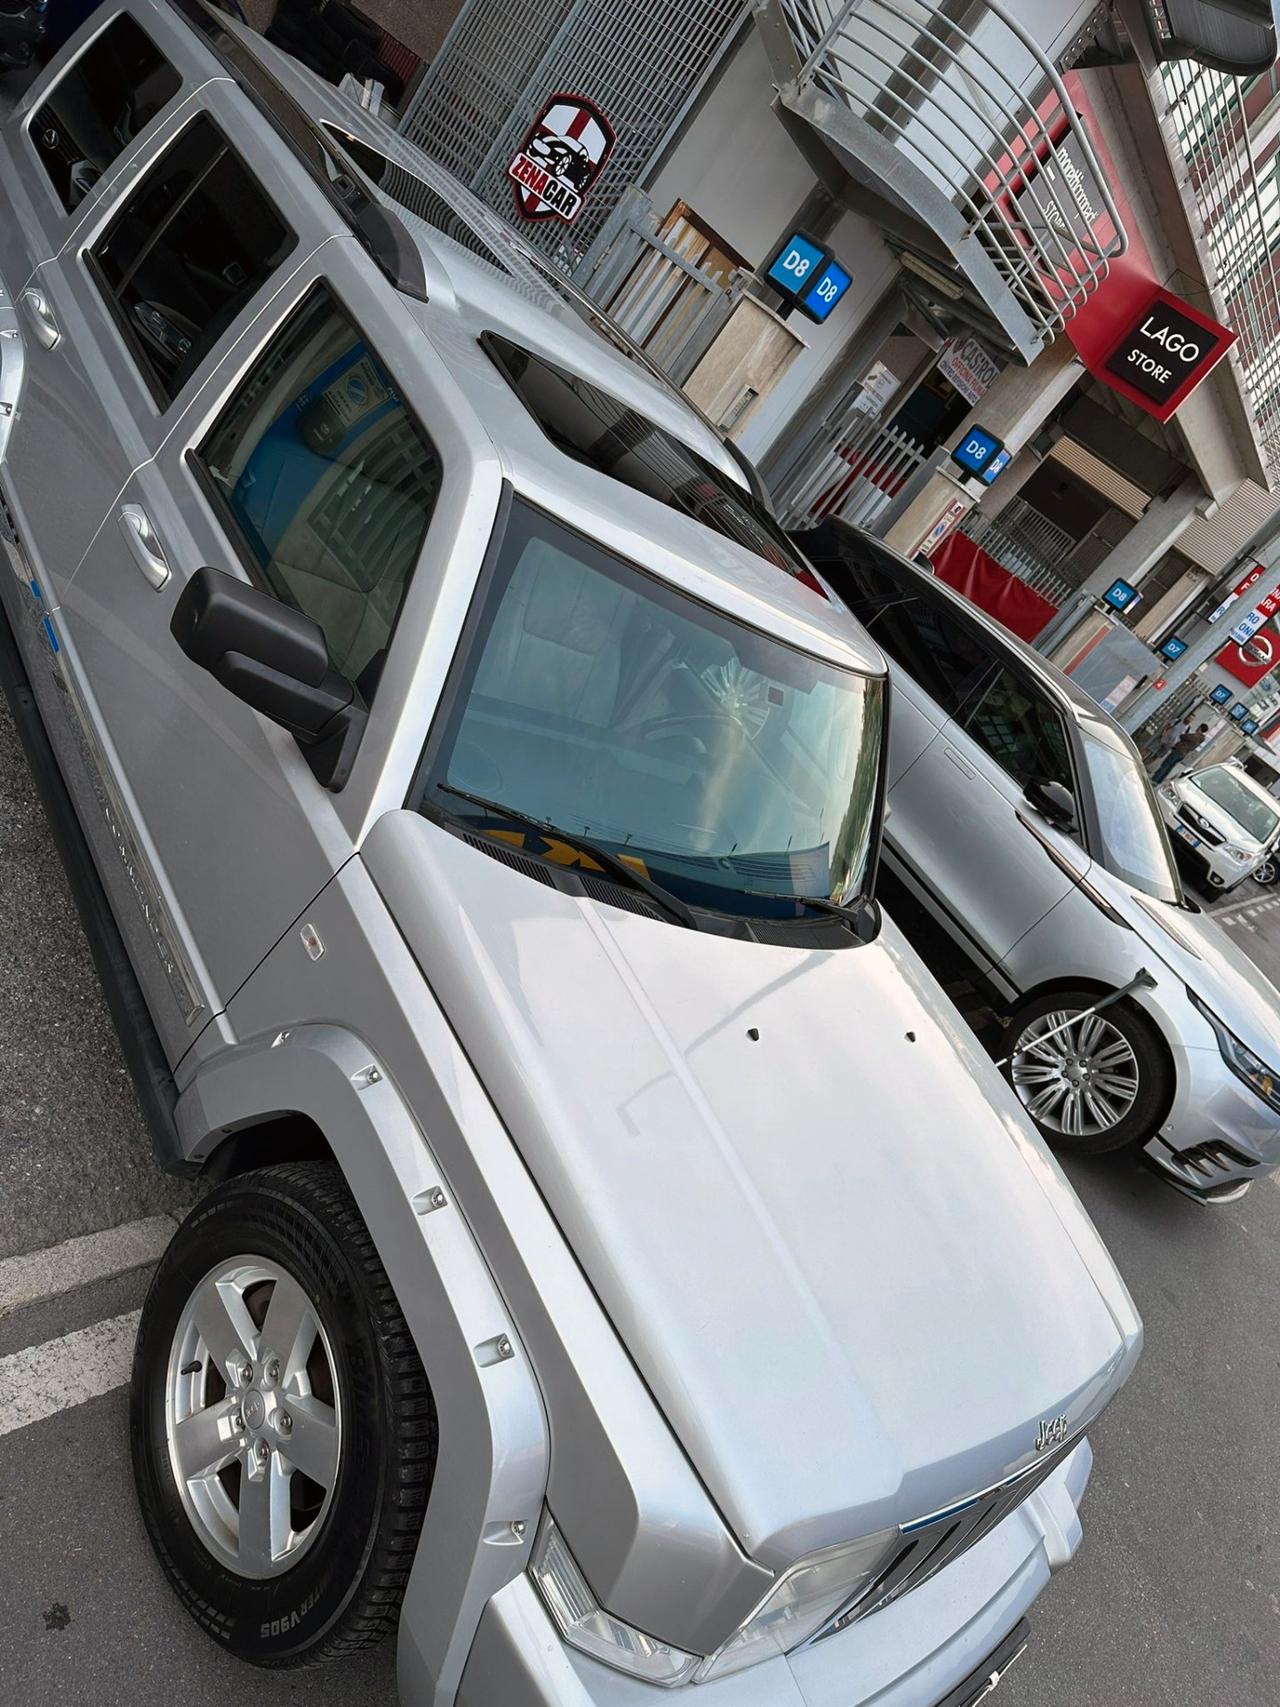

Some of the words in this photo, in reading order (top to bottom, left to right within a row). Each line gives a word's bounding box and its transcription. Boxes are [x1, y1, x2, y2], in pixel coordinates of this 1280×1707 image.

[782, 249, 810, 277] D8
[816, 276, 838, 302] D8
[1140, 316, 1199, 362] LAGO
[1127, 348, 1172, 384] STORE
[966, 440, 986, 459] D8
[1112, 587, 1127, 602] D8
[1167, 642, 1180, 653] D7
[1034, 1414, 1067, 1451] Jeep
